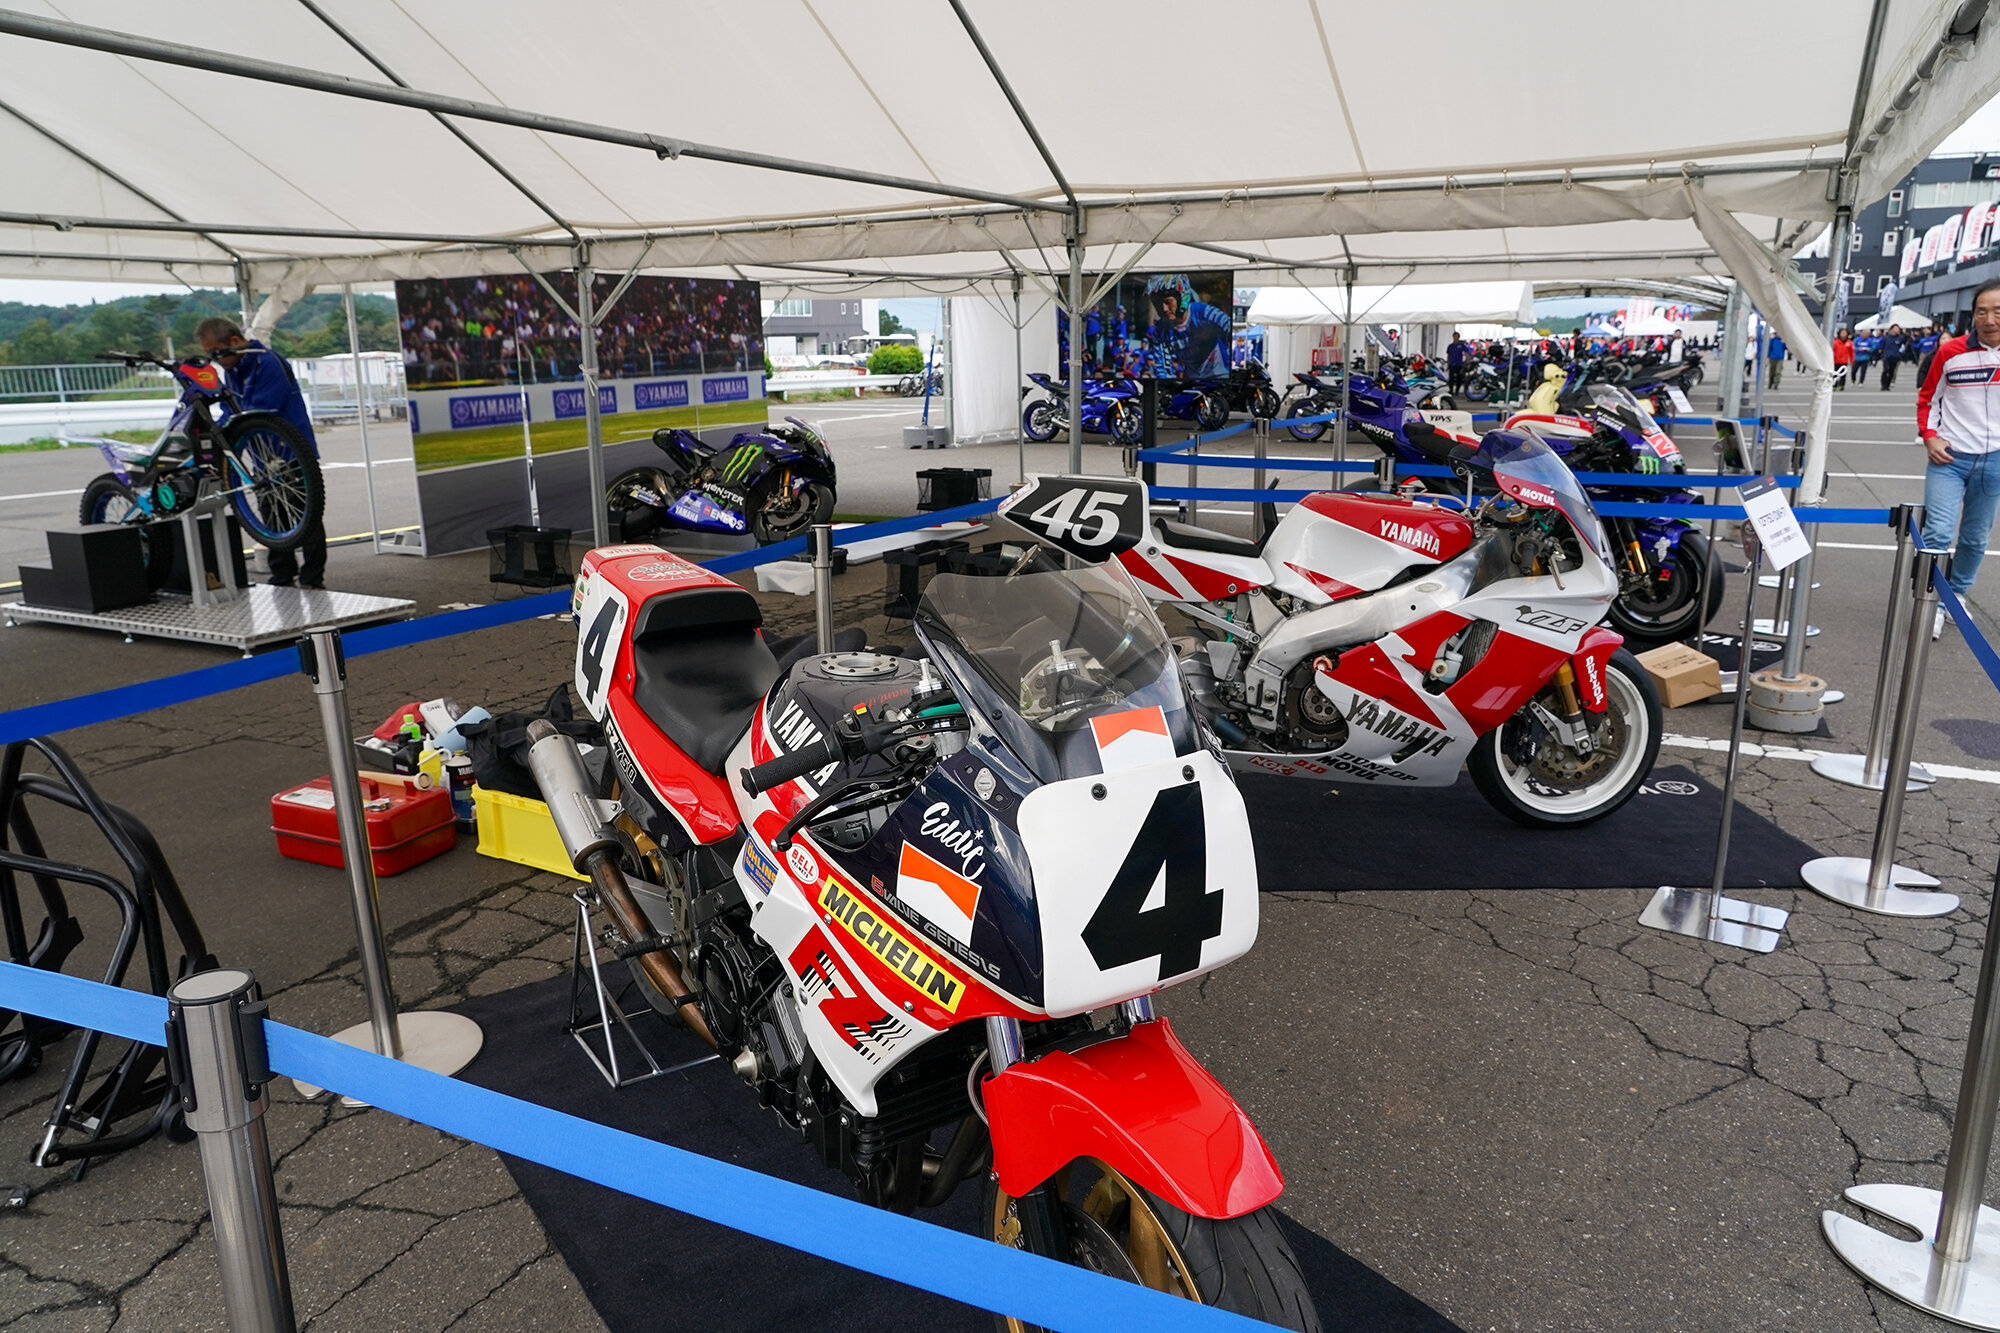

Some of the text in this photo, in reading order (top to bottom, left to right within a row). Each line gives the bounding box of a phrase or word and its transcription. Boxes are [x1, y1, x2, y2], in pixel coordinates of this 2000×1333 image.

[570, 390, 615, 409] YAHA
[648, 384, 687, 401] YAMAHA
[714, 380, 747, 395] YAMAHA
[470, 397, 522, 418] YAMAHA
[1361, 422, 1395, 439] MONSTER
[1554, 417, 1580, 428] YAMAHA
[1596, 416, 1623, 432] YAMAHA
[702, 482, 745, 506] MONSTER
[1520, 487, 1556, 506] MOTUL
[675, 505, 699, 523] YAMAHA
[710, 508, 745, 531] ENEOS
[1030, 487, 1129, 546] 45
[1381, 519, 1440, 555] YAMAHA
[1515, 605, 1588, 634] YZF
[582, 596, 620, 705] 4
[1586, 655, 1604, 705] DUNLOP
[1345, 694, 1455, 757] YAMAHA
[1249, 755, 1292, 776] NGK
[1293, 759, 1328, 775] DID
[1315, 755, 1380, 781] MOTUL
[1336, 752, 1418, 781] DUNLOP
[921, 801, 986, 880] Eddie
[791, 848, 814, 877] BELL
[791, 859, 809, 879] HELMETS
[1080, 780, 1224, 982] 4
[823, 884, 957, 1006] MICHELIN
[923, 921, 1001, 980] GENESIS
